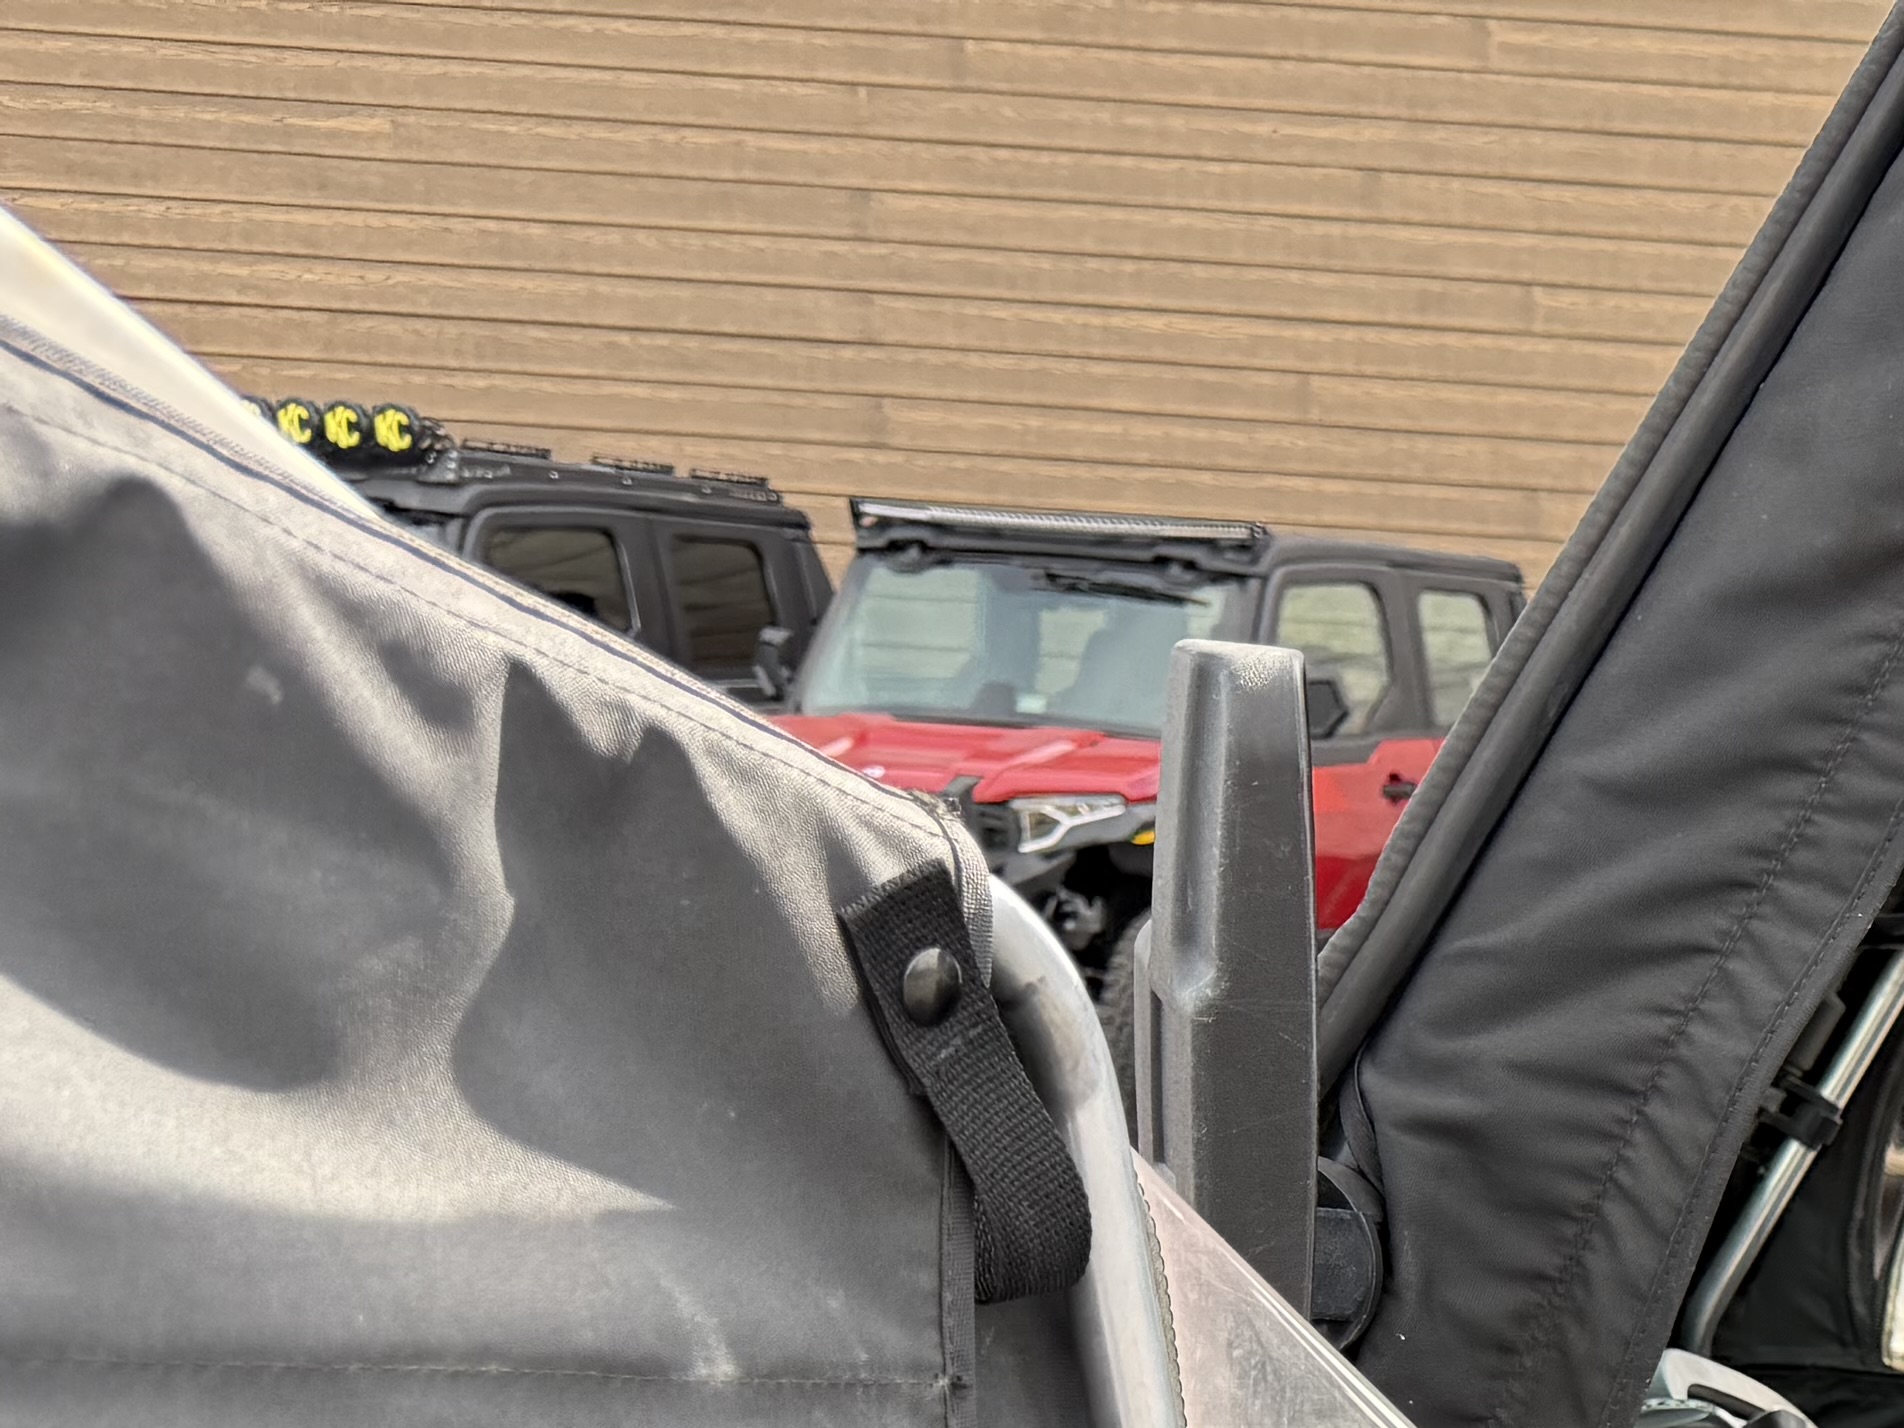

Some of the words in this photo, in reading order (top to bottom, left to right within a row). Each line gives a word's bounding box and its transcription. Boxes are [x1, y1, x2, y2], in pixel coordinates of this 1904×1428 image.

[277, 402, 312, 444] KC
[323, 405, 361, 449] KC
[374, 408, 413, 452] KC
